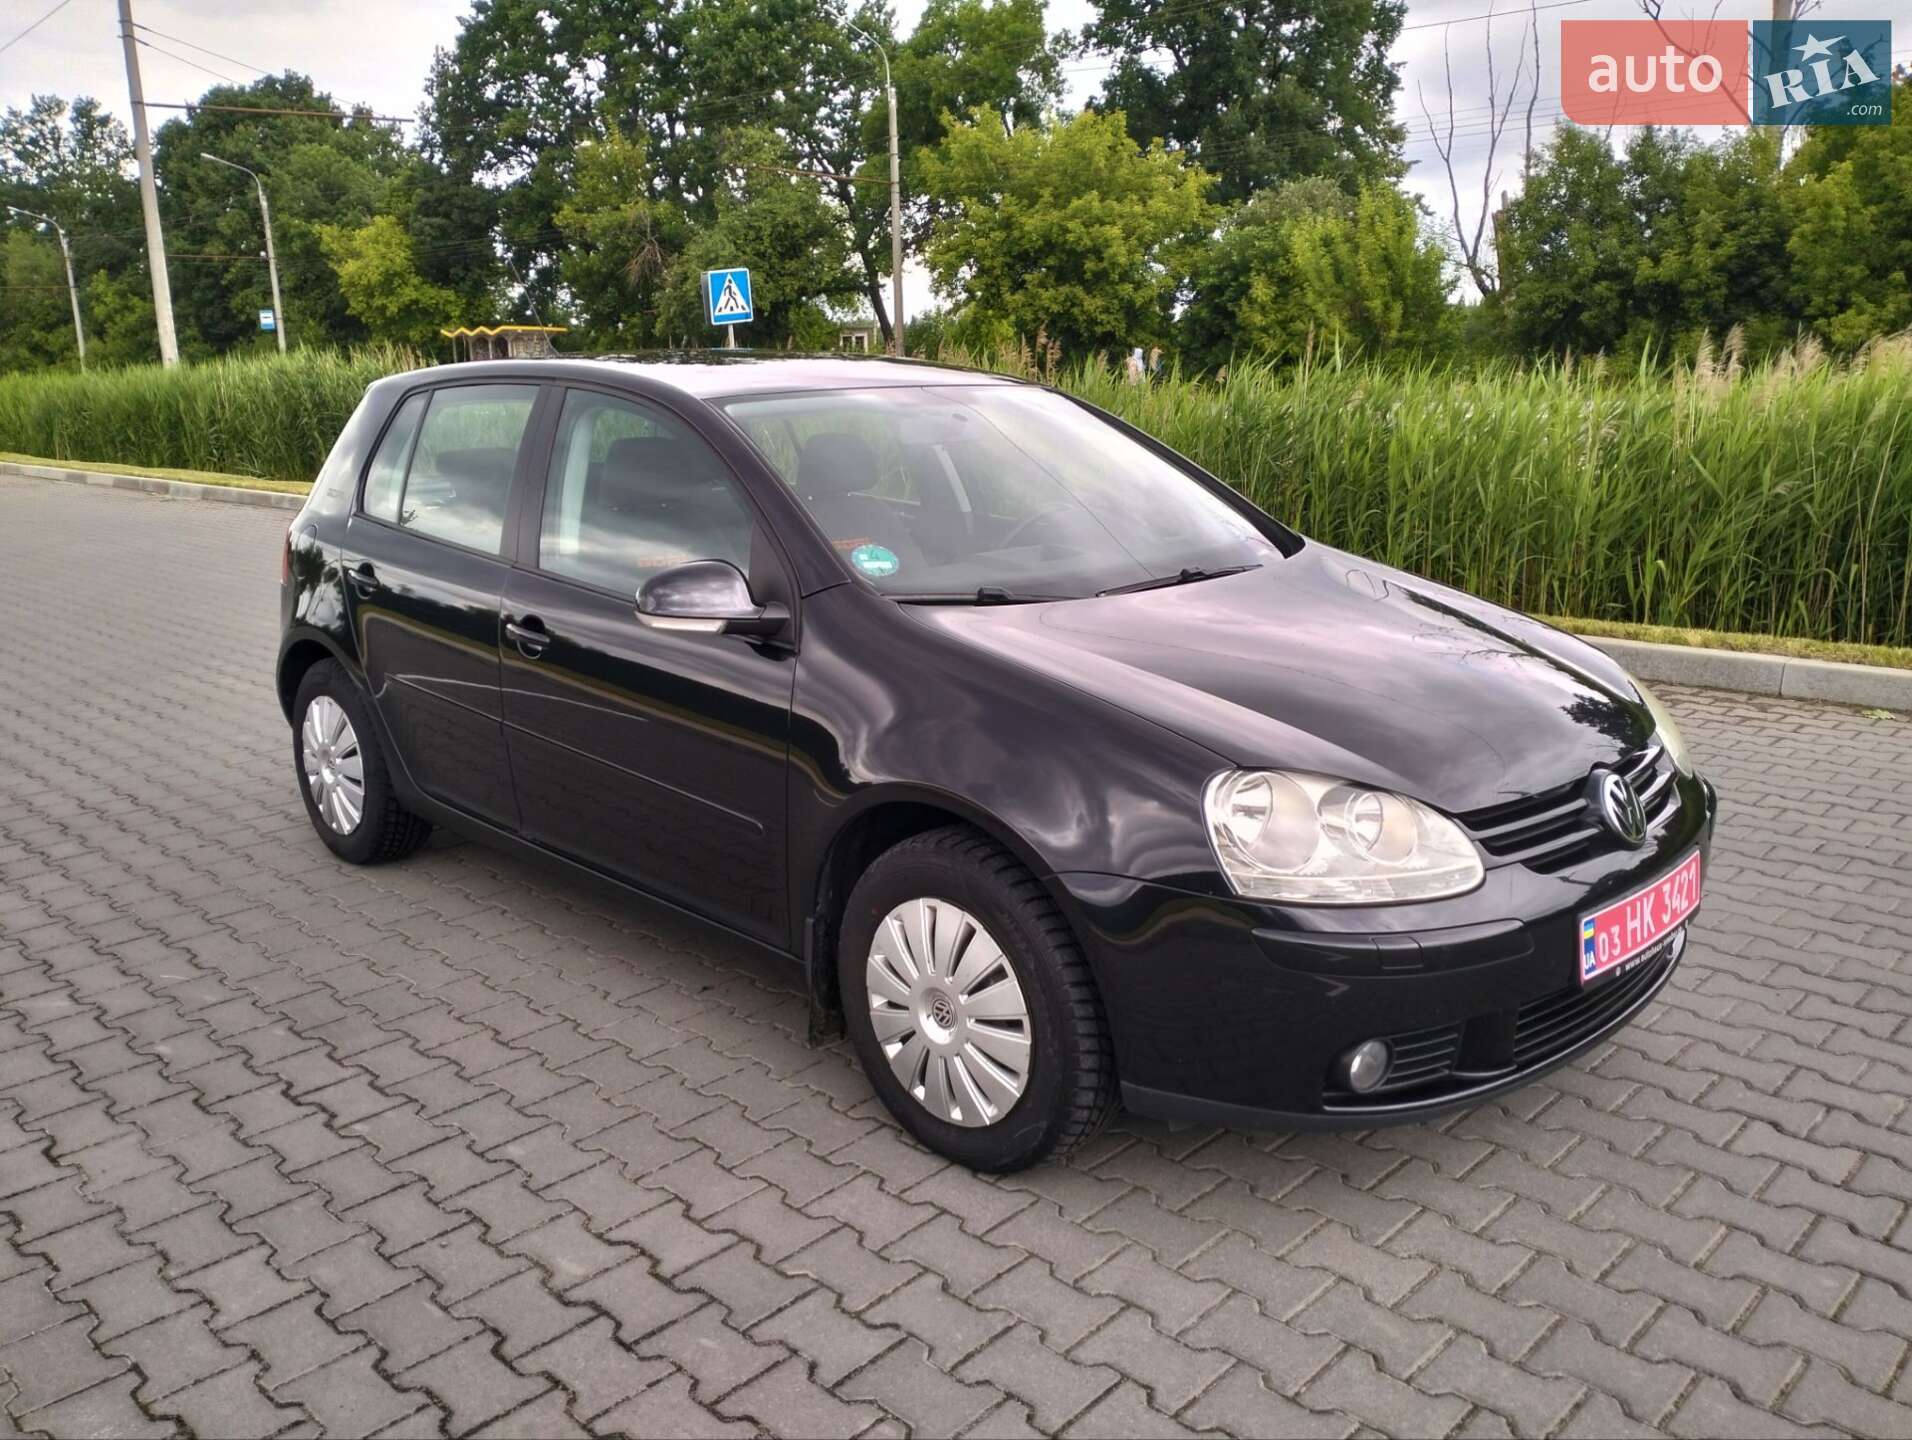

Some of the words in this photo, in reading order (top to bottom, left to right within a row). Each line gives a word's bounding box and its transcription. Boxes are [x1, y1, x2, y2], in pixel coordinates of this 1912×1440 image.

[1598, 924, 1622, 963] 03
[1625, 892, 1656, 948] HK
[1661, 861, 1698, 924] 3421
[1584, 950, 1596, 969] UA
